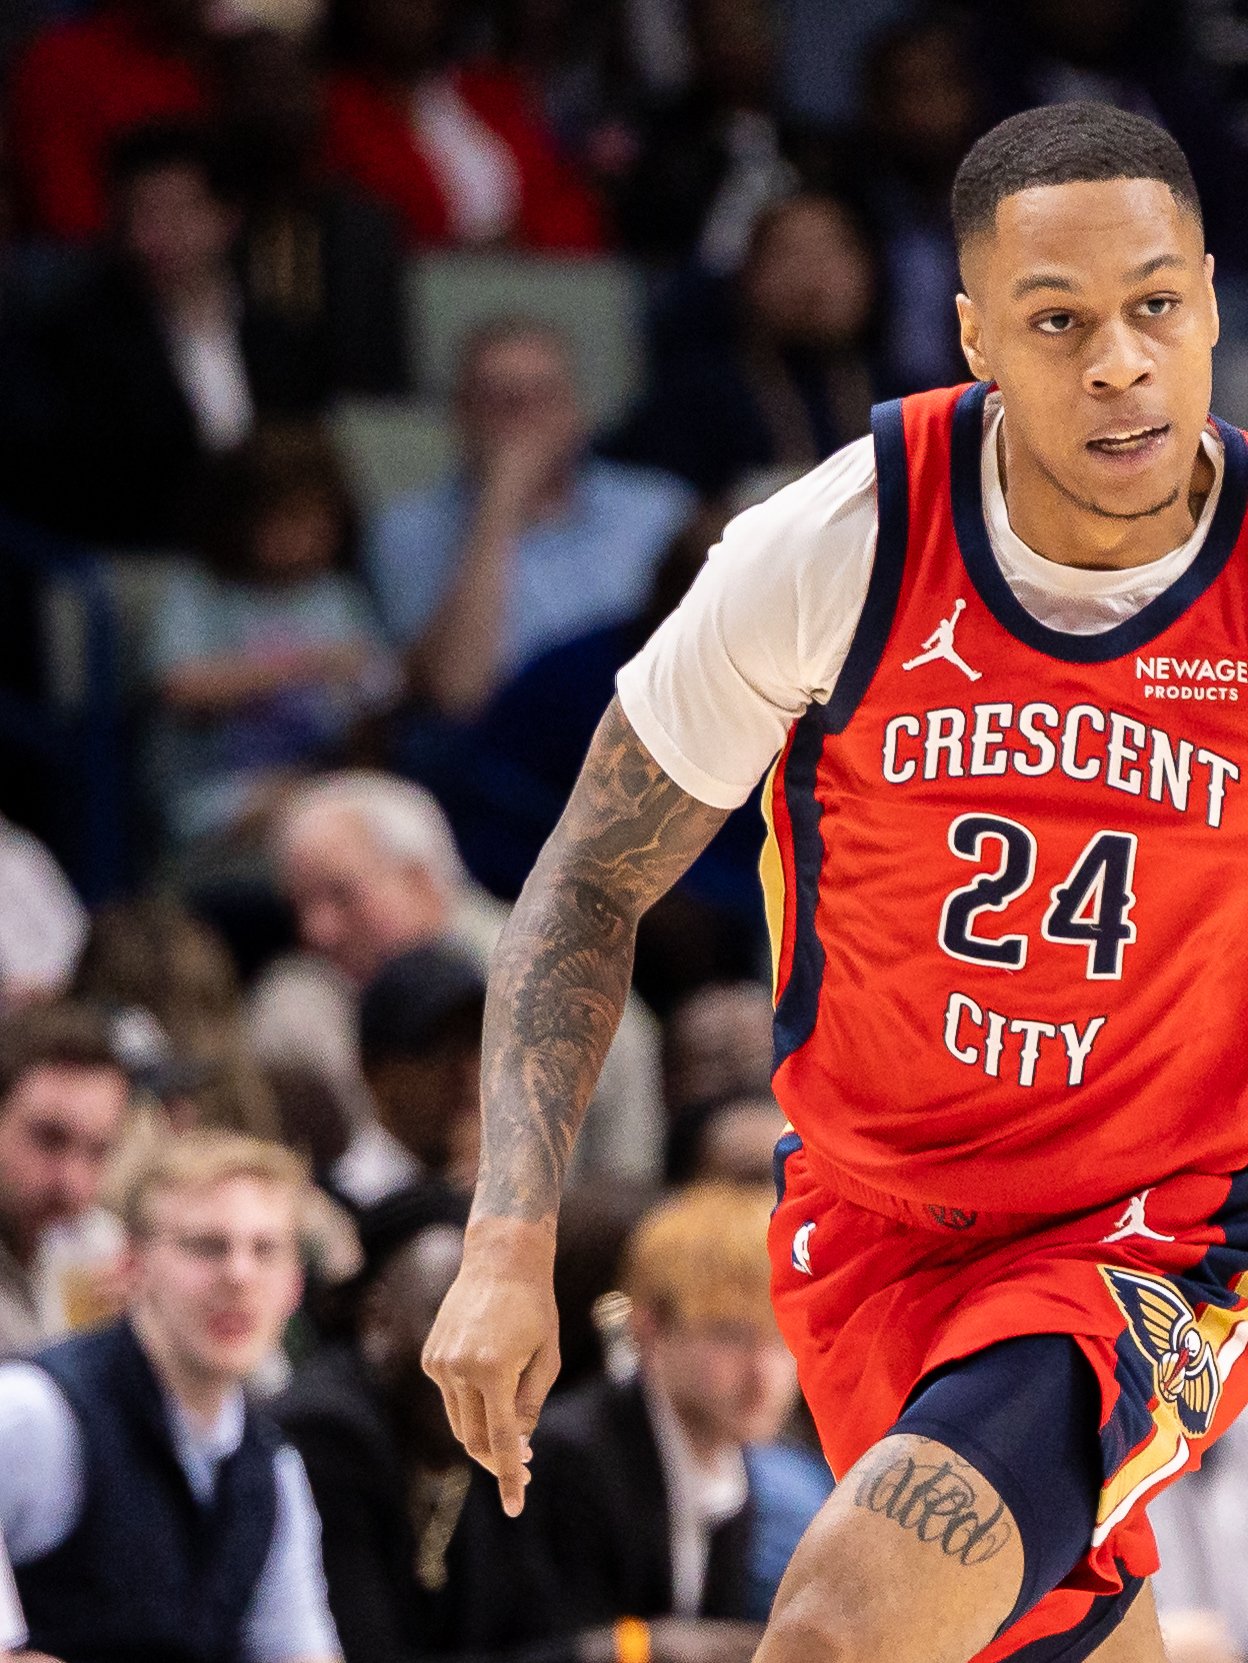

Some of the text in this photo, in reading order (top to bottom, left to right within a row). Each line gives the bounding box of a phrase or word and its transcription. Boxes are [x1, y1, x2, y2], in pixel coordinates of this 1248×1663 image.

[1135, 656, 1248, 683] NEWAGE
[1143, 685, 1239, 701] PRODUCTS
[882, 702, 1241, 829] CRESCENT
[937, 812, 1137, 981] 24
[943, 991, 1108, 1088] CITY
